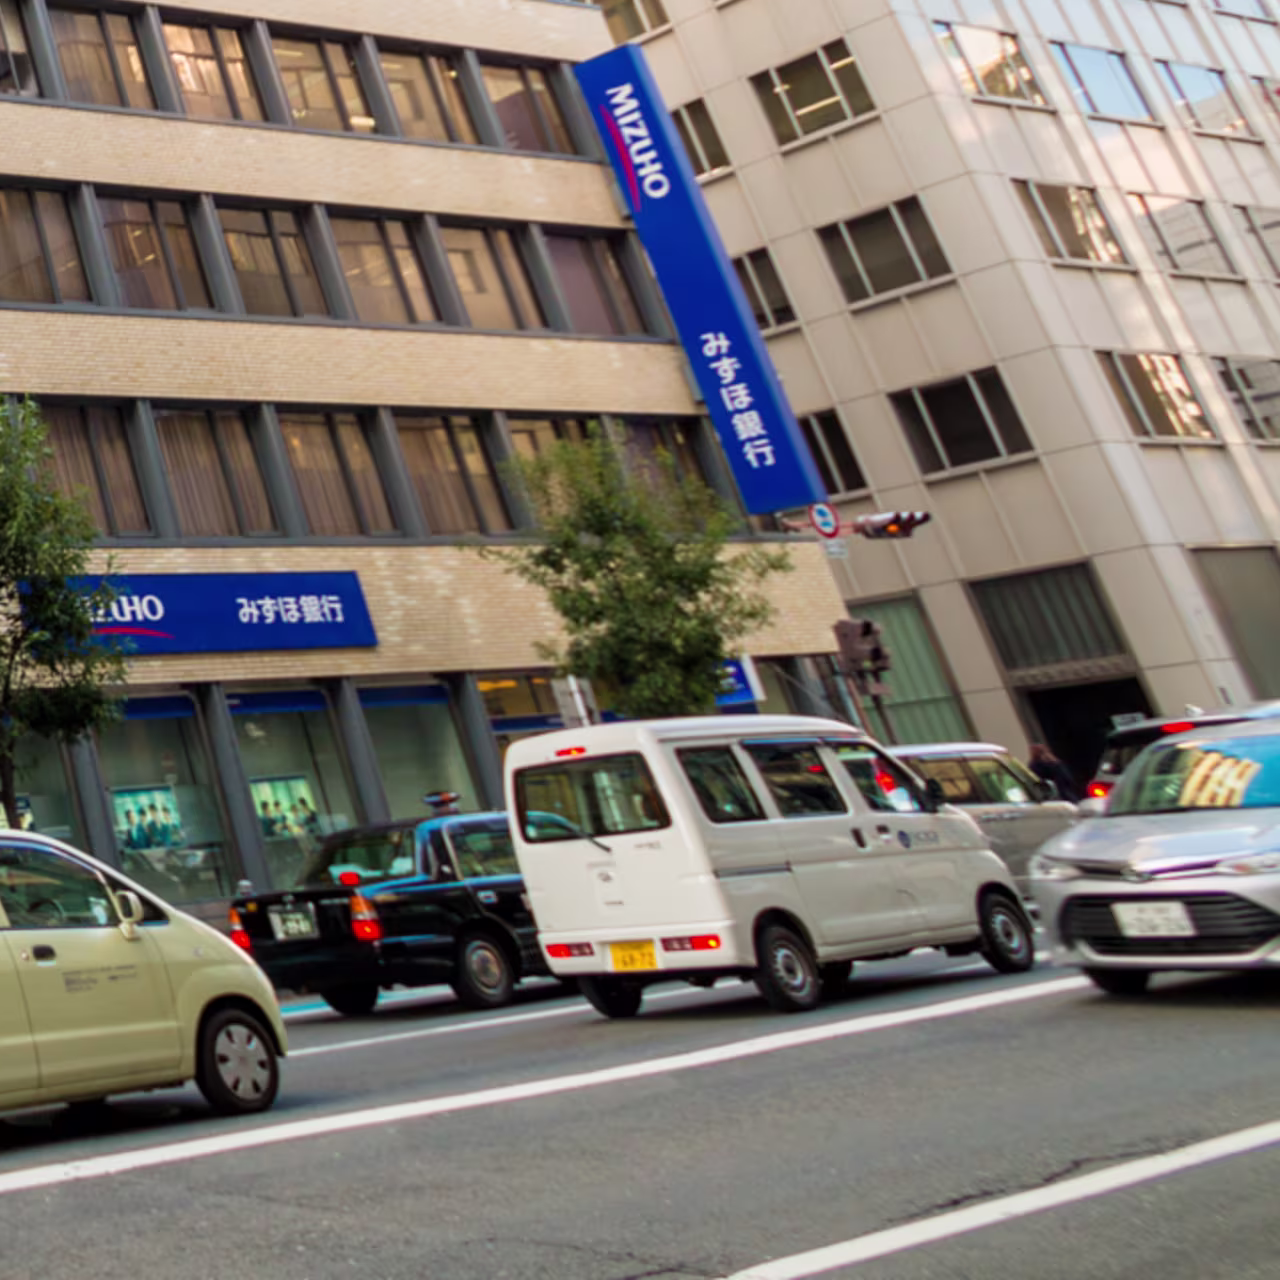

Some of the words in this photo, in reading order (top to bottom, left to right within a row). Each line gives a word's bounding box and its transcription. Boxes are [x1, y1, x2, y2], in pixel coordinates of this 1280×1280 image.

[605, 82, 671, 200] MIZUHO
[699, 331, 777, 469] みずほ銀行
[235, 594, 344, 624] みずほ銀行
